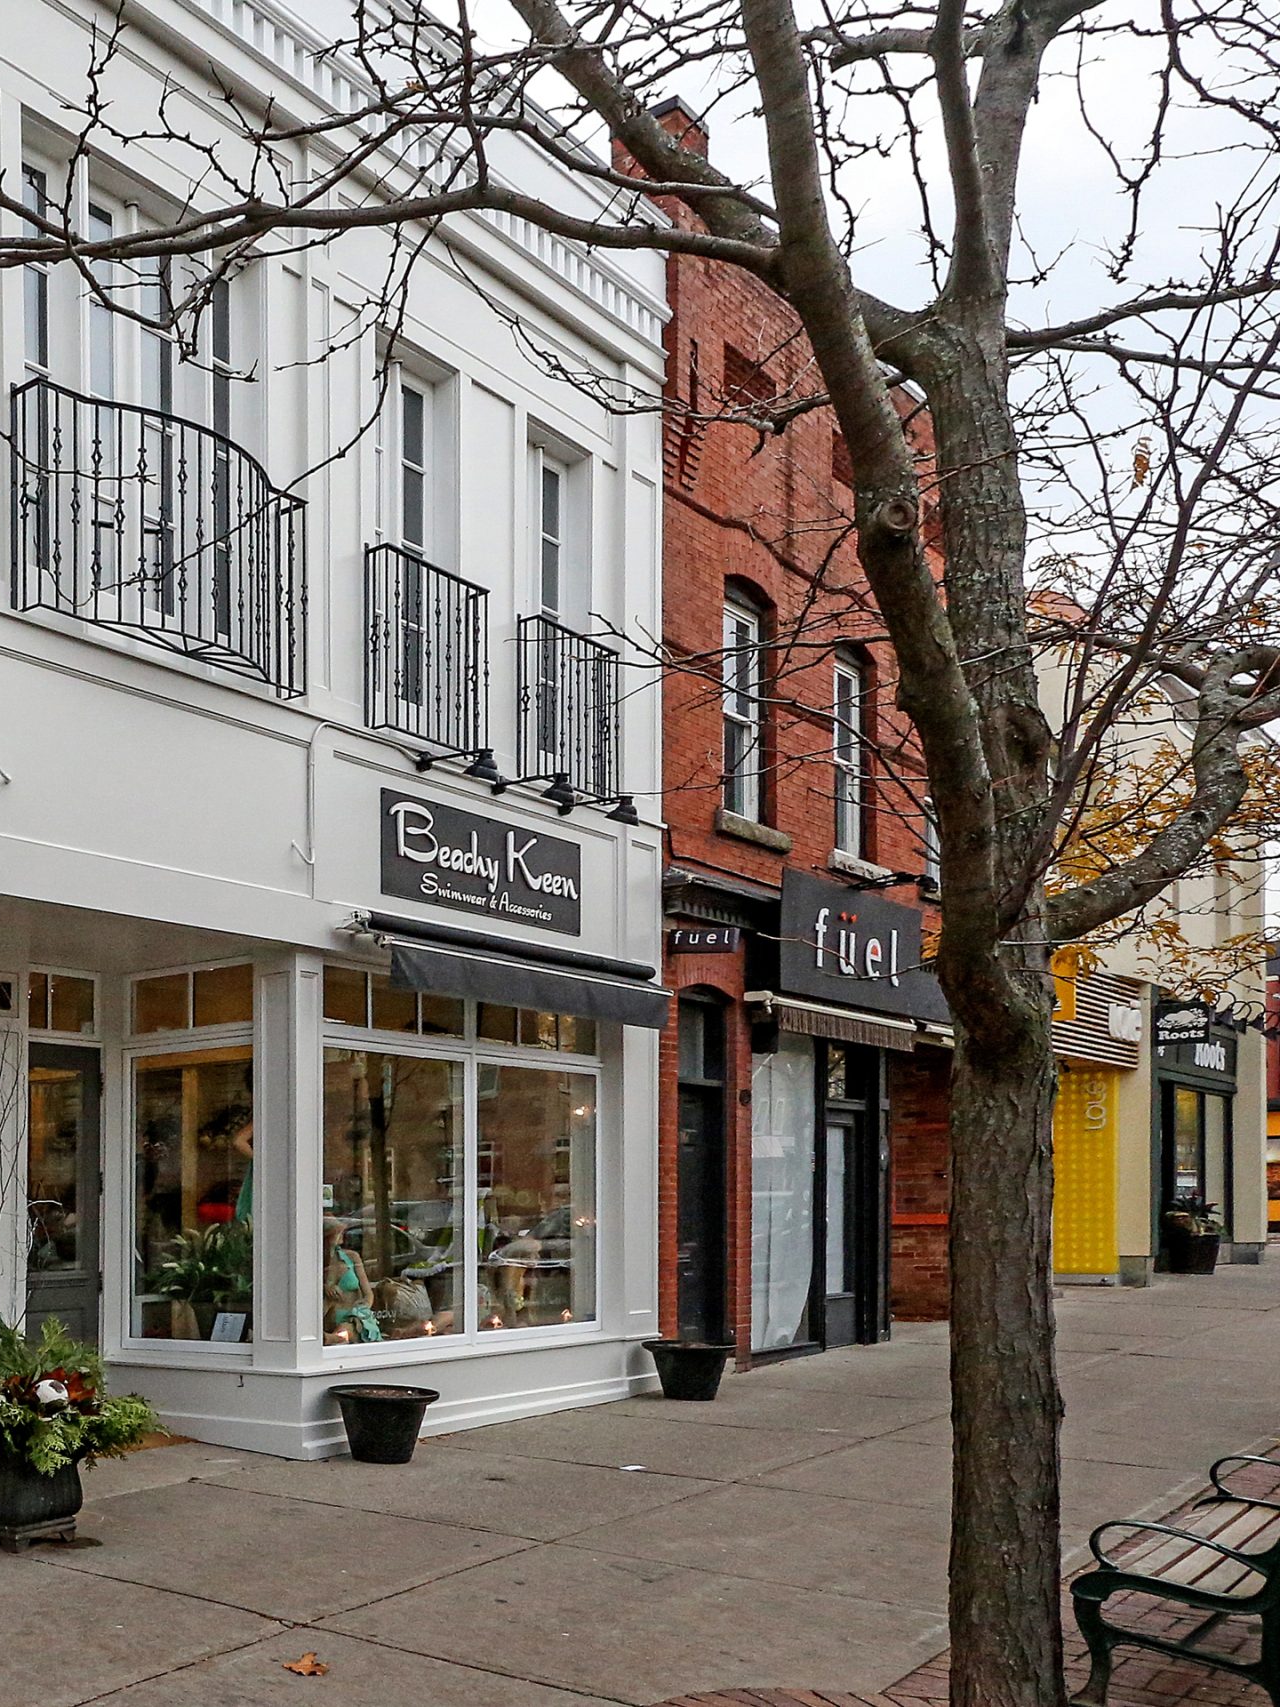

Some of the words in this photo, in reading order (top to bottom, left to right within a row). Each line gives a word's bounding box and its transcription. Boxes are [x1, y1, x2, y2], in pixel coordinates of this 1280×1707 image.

[389, 801, 499, 892] Beachy
[507, 830, 578, 900] Keen
[420, 872, 486, 907] Swimwear
[489, 895, 497, 910] &
[498, 892, 552, 921] Accessories
[674, 930, 730, 945] fuel
[1158, 1030, 1205, 1040] Roots
